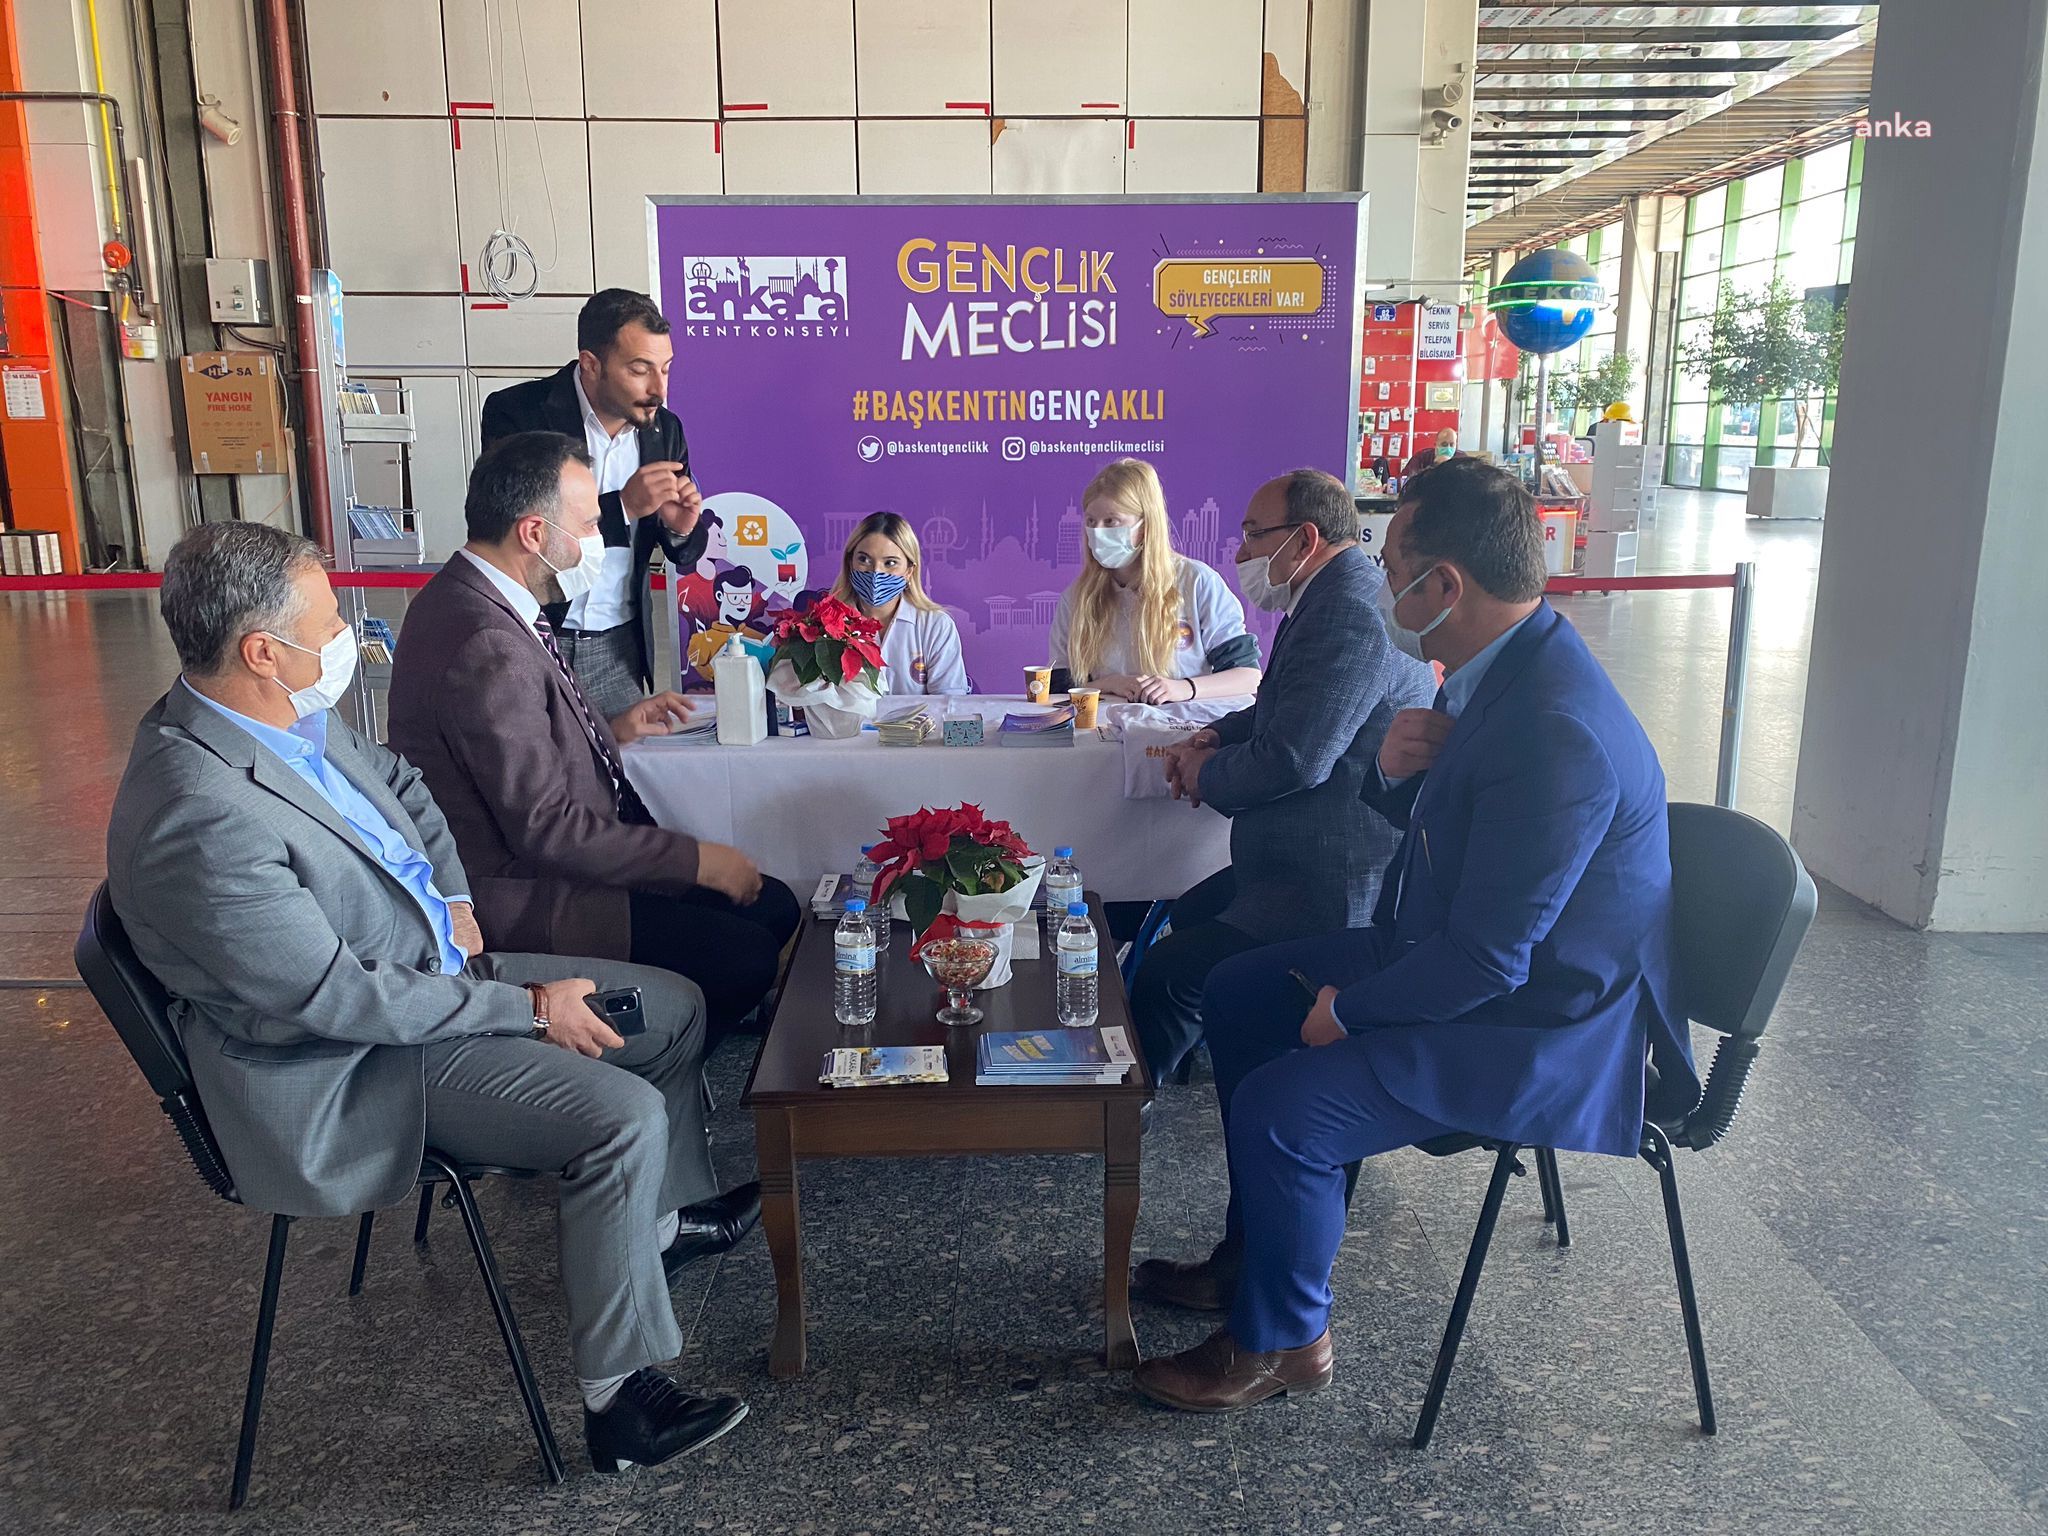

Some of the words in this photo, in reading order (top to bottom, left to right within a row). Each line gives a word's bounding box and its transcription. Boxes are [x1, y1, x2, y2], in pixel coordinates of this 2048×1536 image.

[897, 238, 1117, 302] GENÇLİK
[1203, 266, 1271, 288] GENÇLERİN
[688, 274, 846, 320] ankara
[1169, 289, 1272, 308] SÖYLEYECEKLERİ
[1276, 291, 1305, 307] VAR!
[1492, 286, 1605, 303] ELEKOM
[686, 325, 742, 337] KENT
[902, 300, 1116, 360] MECLİSİ
[1428, 320, 1450, 330] SERVİS
[1424, 335, 1452, 345] TELEFON
[1419, 347, 1455, 358] BİLGİSAYAR
[236, 367, 253, 376] SA
[205, 391, 253, 402] YANGIN
[207, 404, 226, 412] FIRE
[229, 404, 253, 412] HOSE
[887, 440, 989, 456] @baskentgenclikk
[1029, 439, 1165, 456] @baskentgenclikmeclisi
